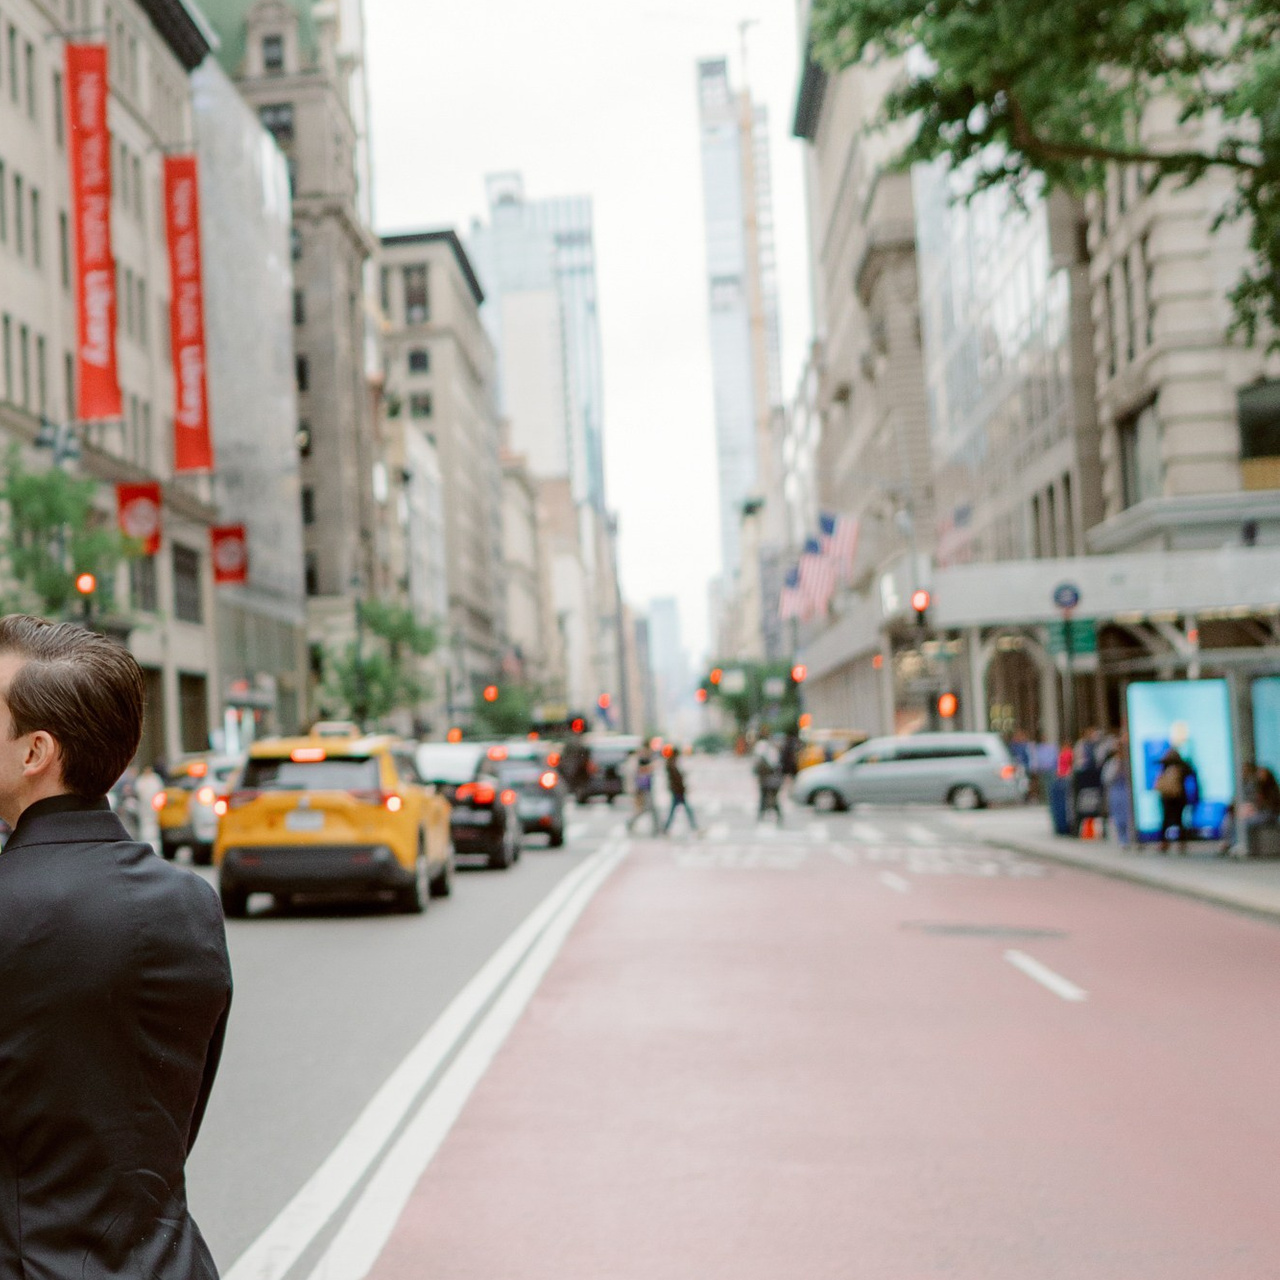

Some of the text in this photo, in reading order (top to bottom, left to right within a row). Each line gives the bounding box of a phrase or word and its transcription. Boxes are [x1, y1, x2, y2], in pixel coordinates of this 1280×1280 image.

[77, 72, 110, 367] New York Public Library
[172, 179, 192, 227] New
[175, 233, 195, 276] York
[177, 345, 202, 428] Library
